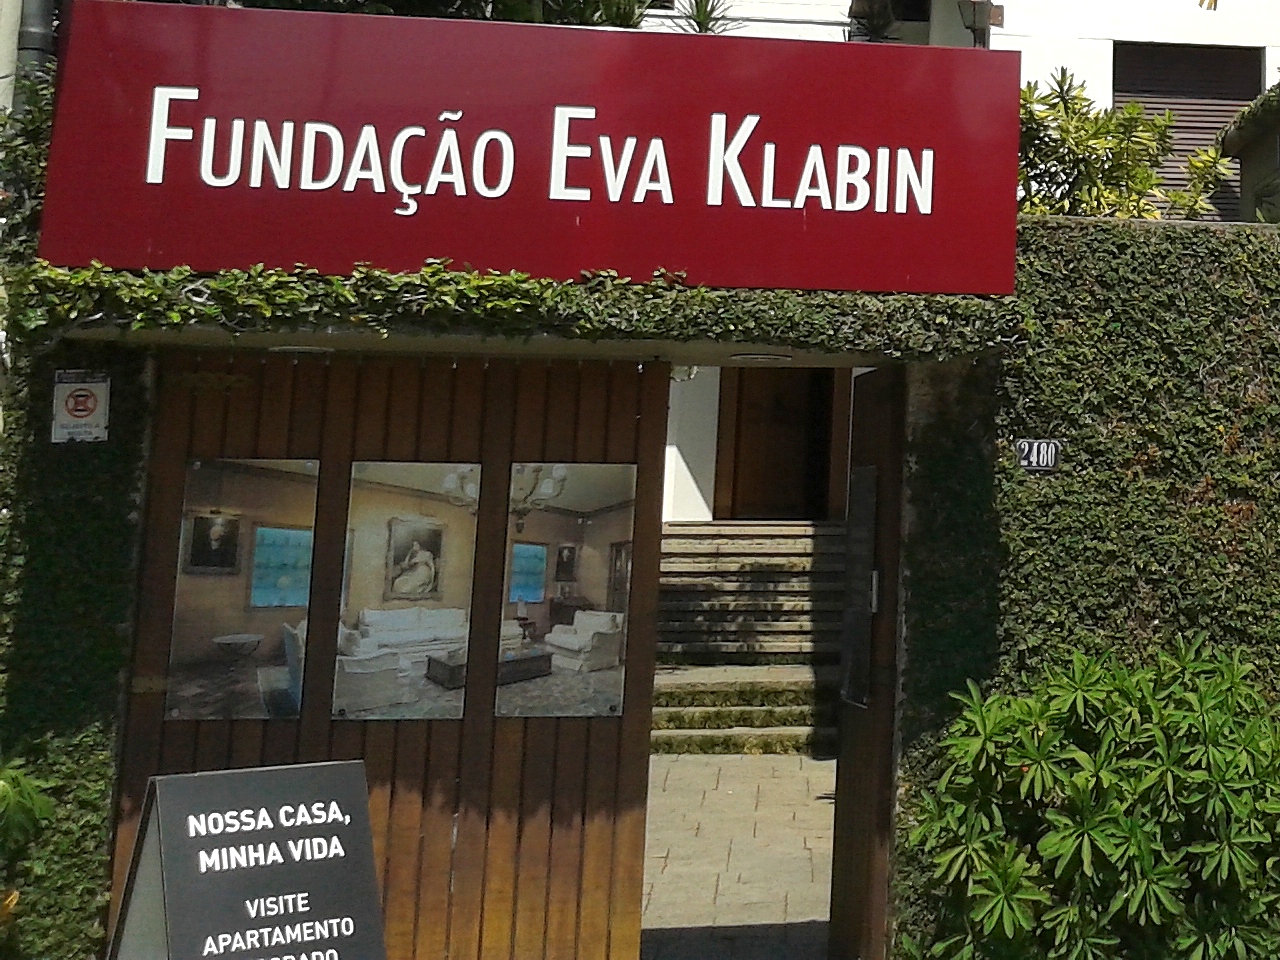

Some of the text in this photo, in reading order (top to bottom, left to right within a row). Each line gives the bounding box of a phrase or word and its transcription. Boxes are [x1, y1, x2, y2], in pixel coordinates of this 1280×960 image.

[145, 86, 934, 217] FUNDAÇÃO EVA KLABIN
[1020, 441, 1056, 467] 2480
[187, 800, 351, 837] NOSSA CASA,
[199, 835, 345, 874] MINHA VIDA
[245, 892, 311, 919] VISITE
[202, 917, 354, 957] APARTAMENTO
